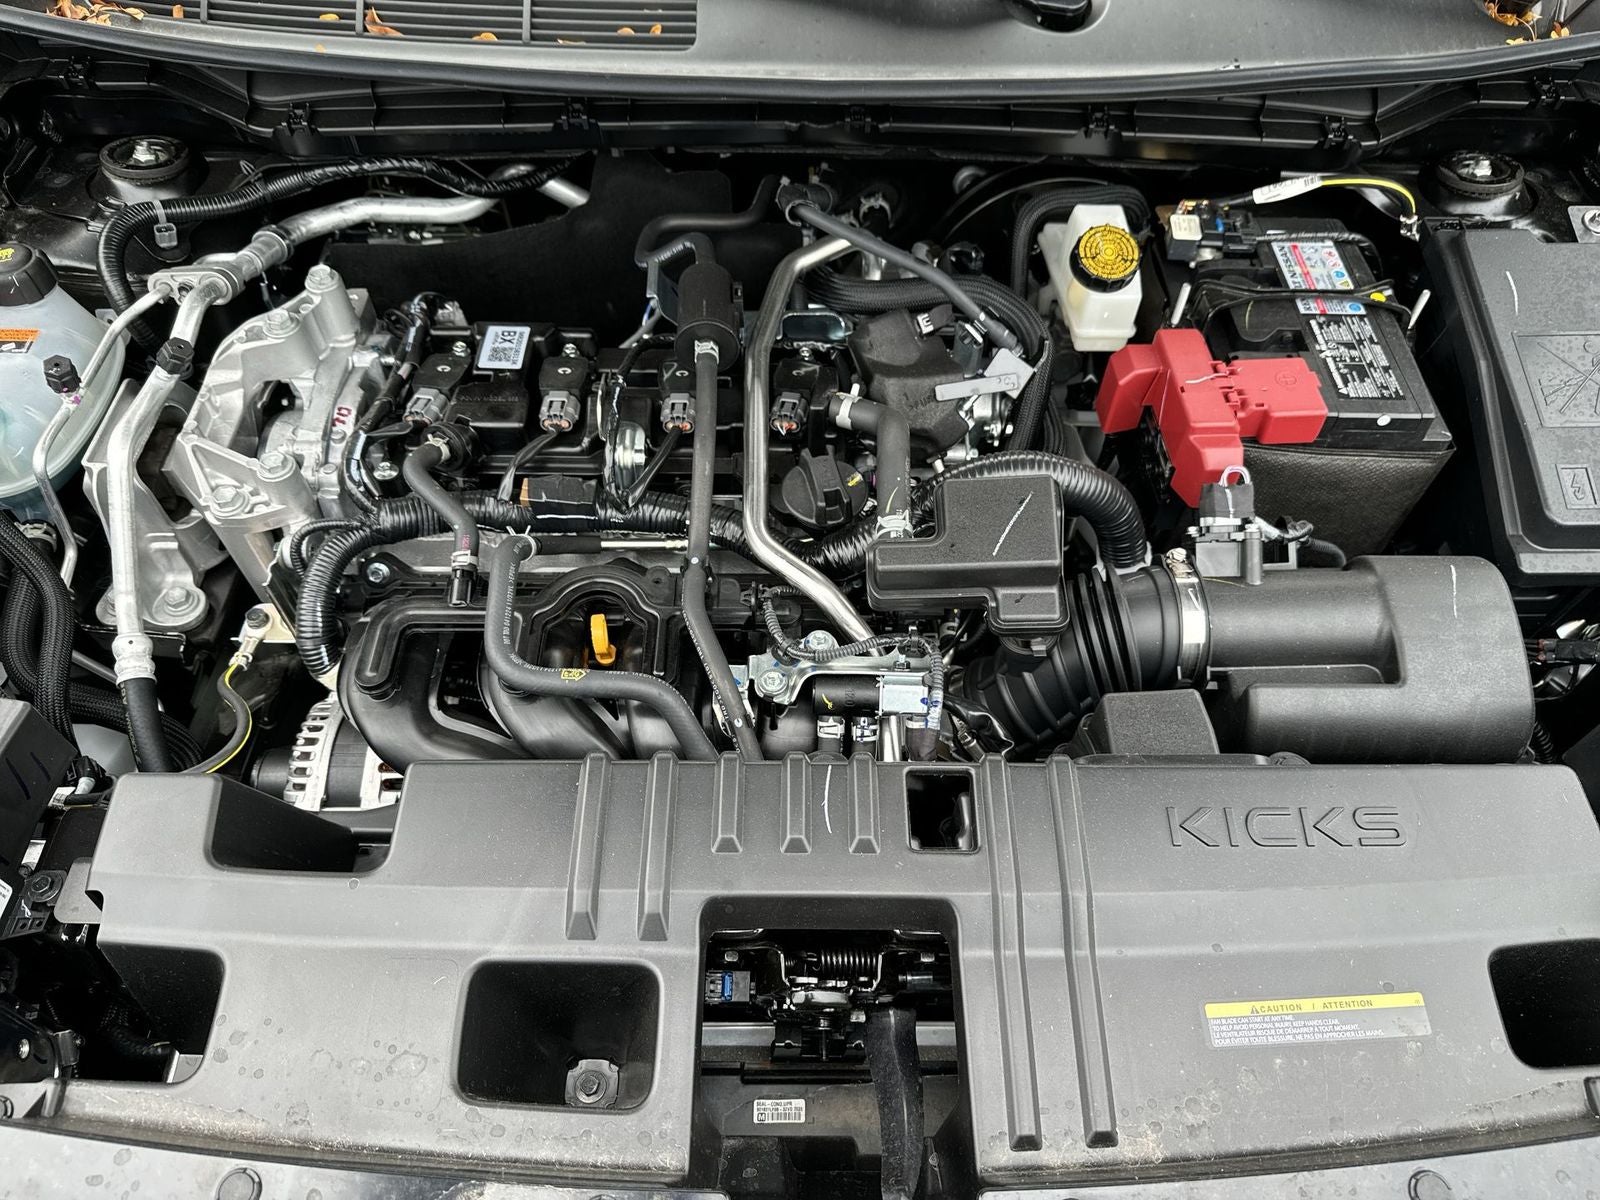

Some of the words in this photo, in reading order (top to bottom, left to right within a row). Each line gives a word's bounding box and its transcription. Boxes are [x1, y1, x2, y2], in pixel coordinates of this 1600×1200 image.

[1278, 245, 1297, 278] NISSAN
[499, 330, 517, 344] BX
[1164, 805, 1407, 848] KICKS
[1260, 1004, 1302, 1013] CAUTION
[1323, 1000, 1373, 1009] ATTENTION
[1221, 1030, 1256, 1038] VENTILATEUR
